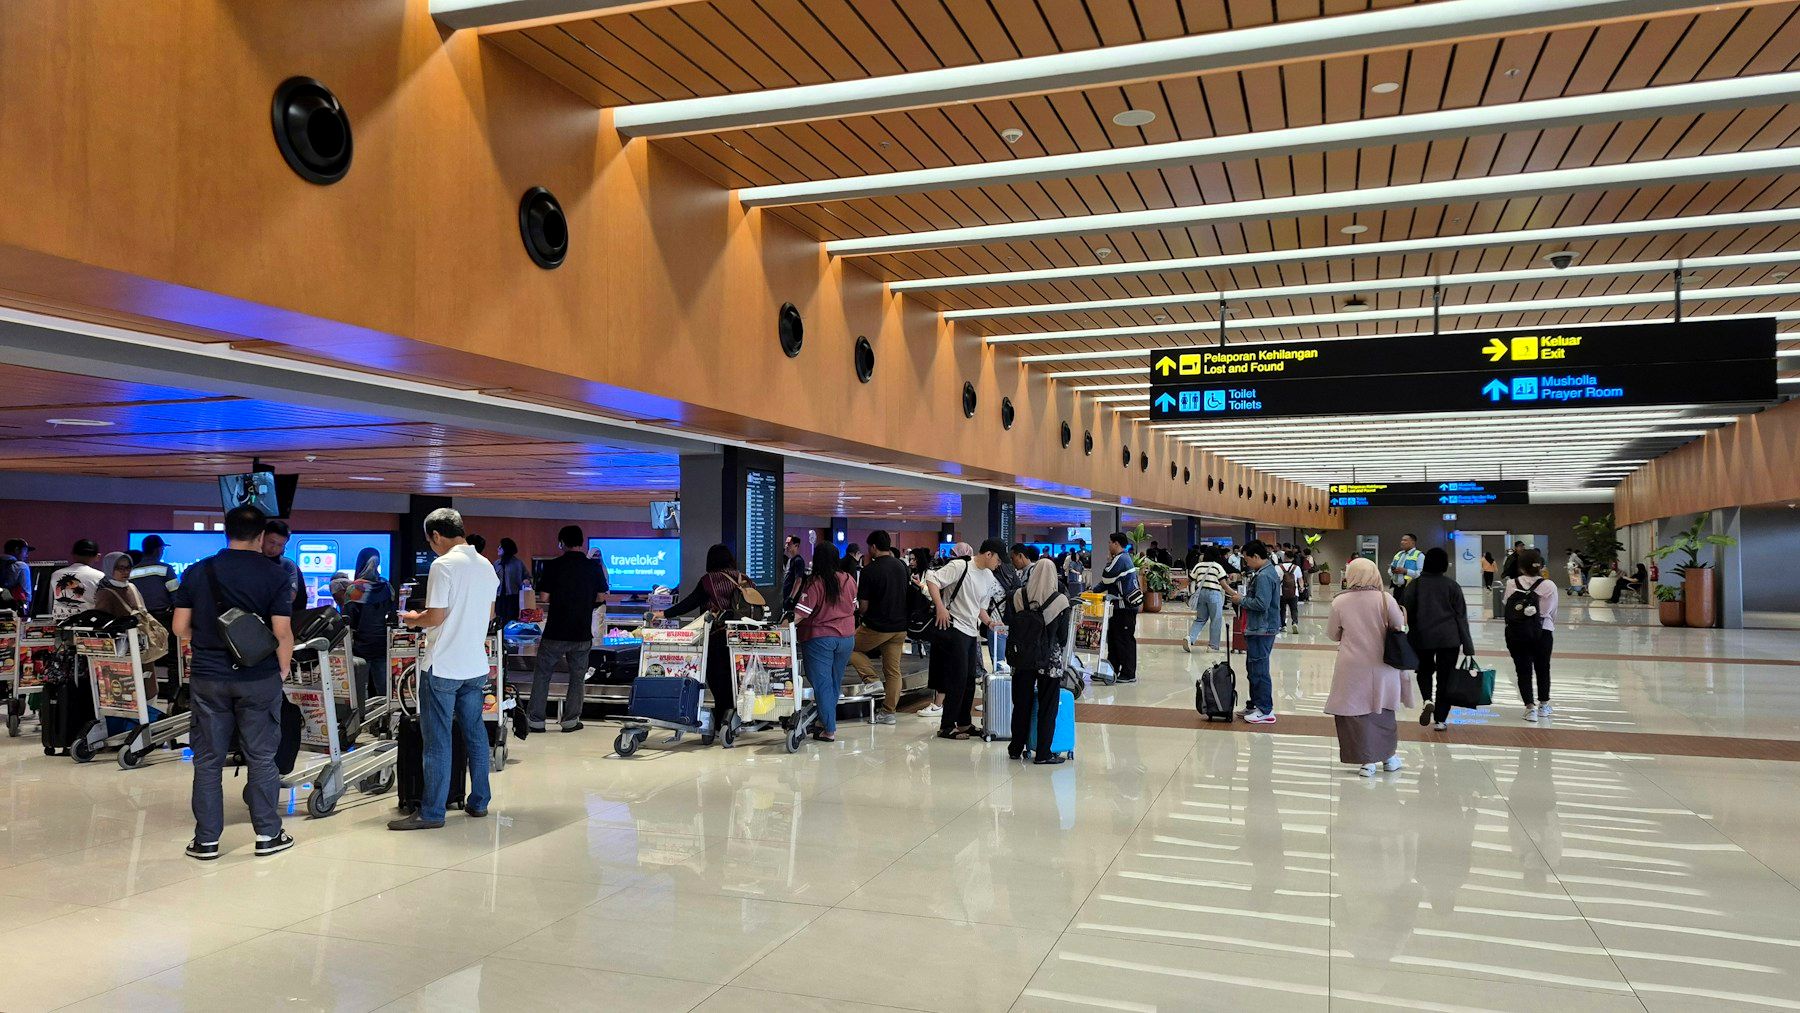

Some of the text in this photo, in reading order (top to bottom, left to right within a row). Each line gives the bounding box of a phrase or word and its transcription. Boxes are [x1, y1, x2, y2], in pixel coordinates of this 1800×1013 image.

[1541, 335, 1582, 347] Keluar
[1204, 349, 1319, 364] Pelaporan Kehilangan
[1541, 348, 1565, 359] Exit
[1204, 361, 1284, 374] Lost and Found
[1541, 375, 1597, 386] Musholla
[1229, 389, 1256, 398] Toilet
[1542, 387, 1623, 401] Prayer Room
[1229, 400, 1262, 410] Toilets
[611, 554, 659, 566] traveloka
